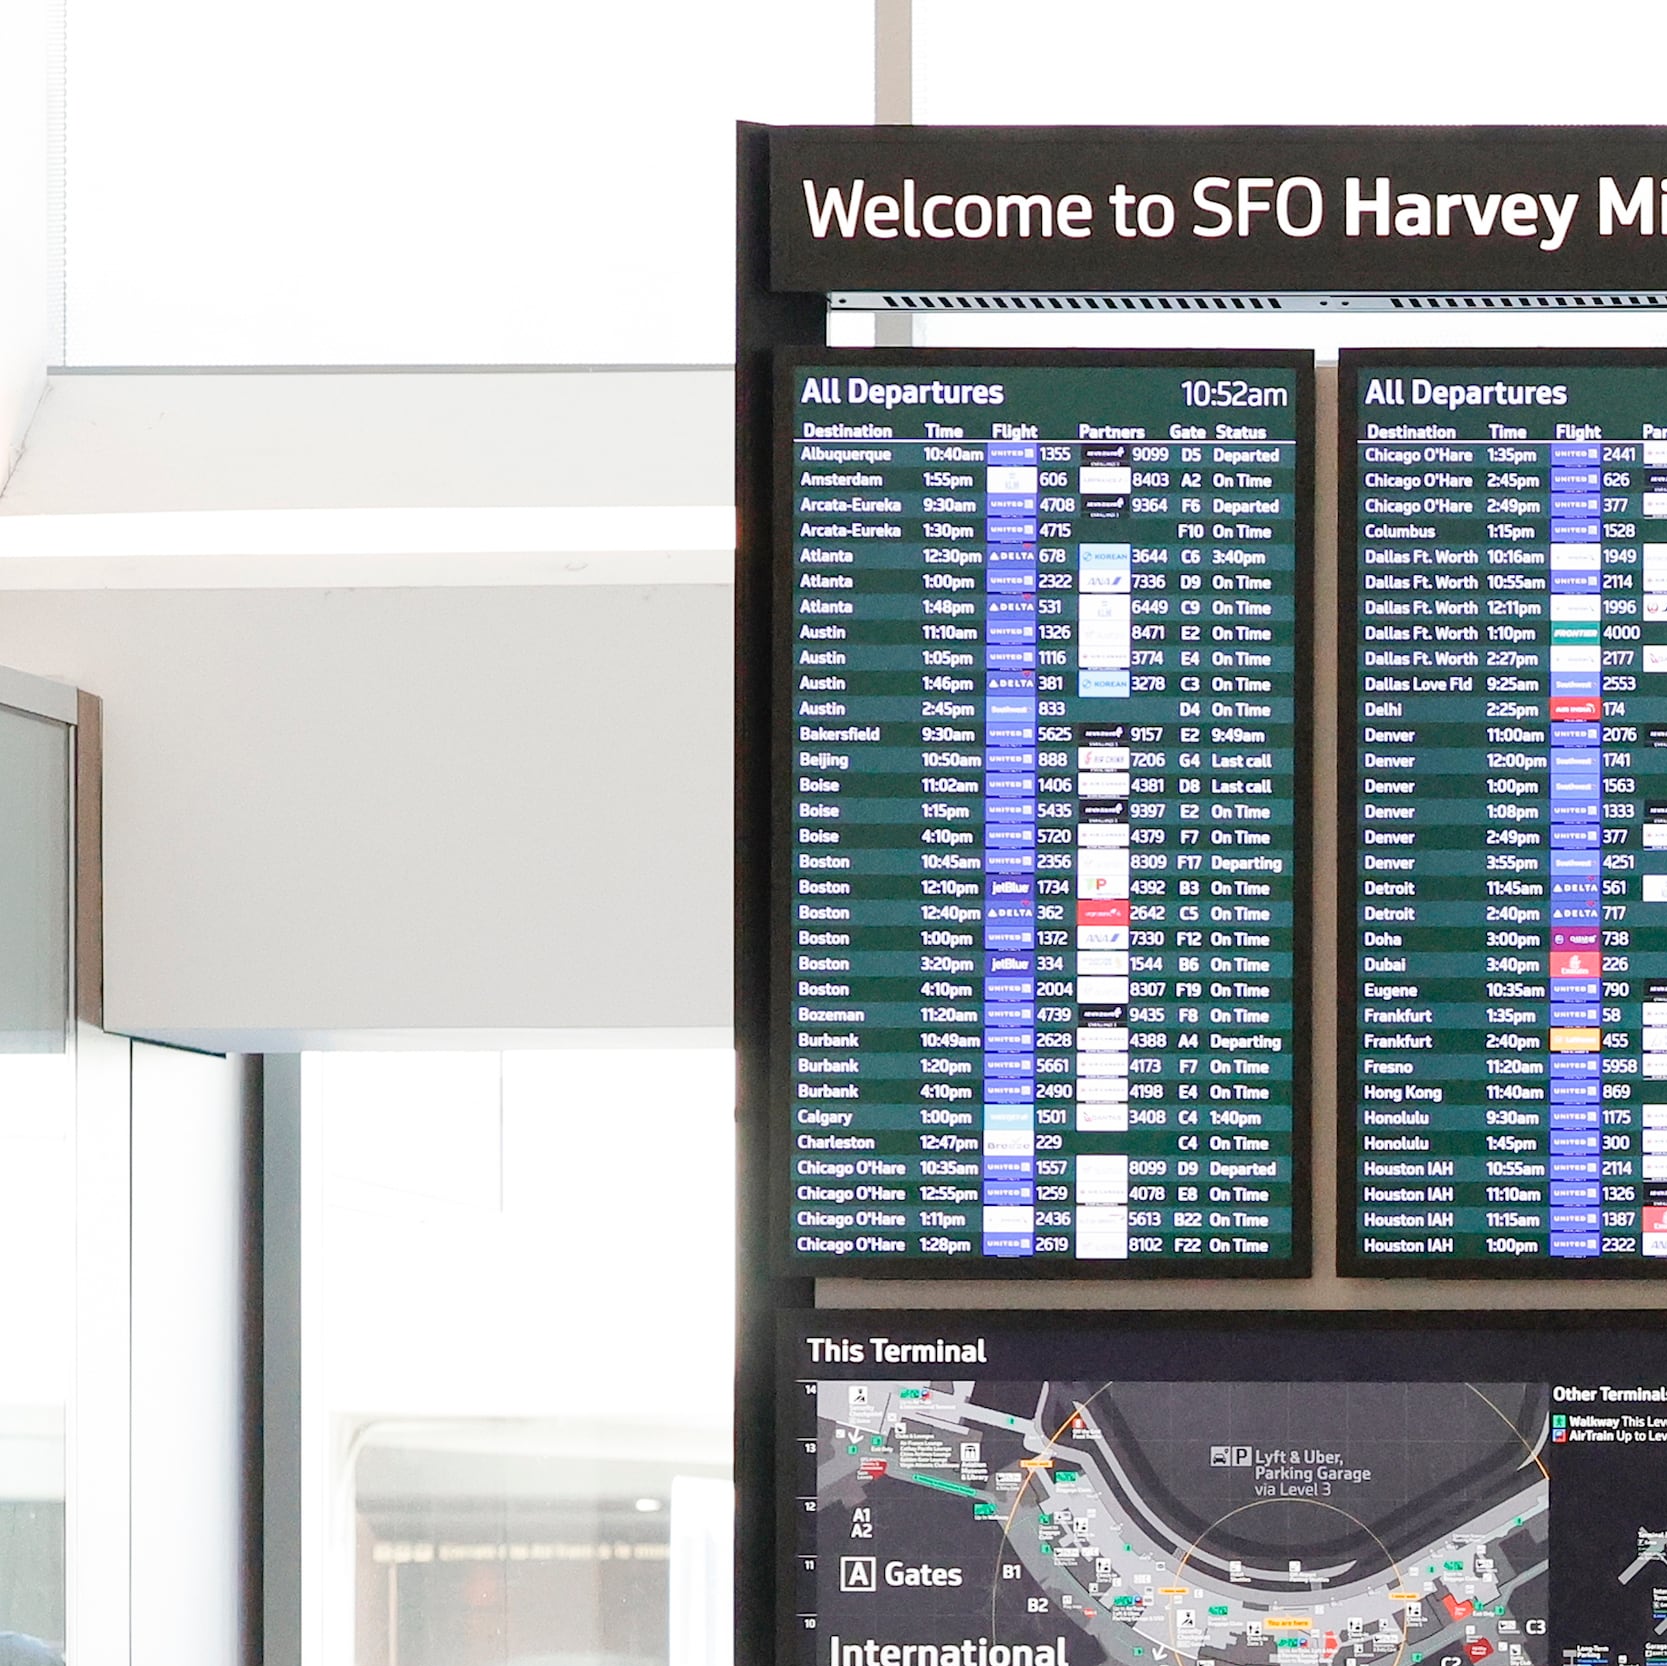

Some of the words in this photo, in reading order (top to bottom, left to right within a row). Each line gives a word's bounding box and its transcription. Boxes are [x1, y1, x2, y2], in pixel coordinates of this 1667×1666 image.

[802, 178, 1093, 239] Welcome
[1108, 184, 1175, 238] to
[1192, 176, 1323, 238] SFO
[1345, 177, 1579, 251] Harvey
[800, 377, 842, 404] All
[848, 377, 1004, 410] Departures
[1181, 380, 1288, 407] 10:52am
[800, 547, 854, 563] Atlanta
[922, 548, 983, 567] 12:30pm
[1000, 551, 1035, 561] DELTA
[1038, 548, 1066, 563] 678
[1131, 548, 1168, 564] 3644
[1180, 549, 1201, 564] C6
[1212, 549, 1266, 568] 3:40pm
[806, 1337, 865, 1363] This
[869, 1337, 988, 1363] Terminal
[1552, 1385, 1598, 1402] Other
[884, 1561, 963, 1587] Gates
